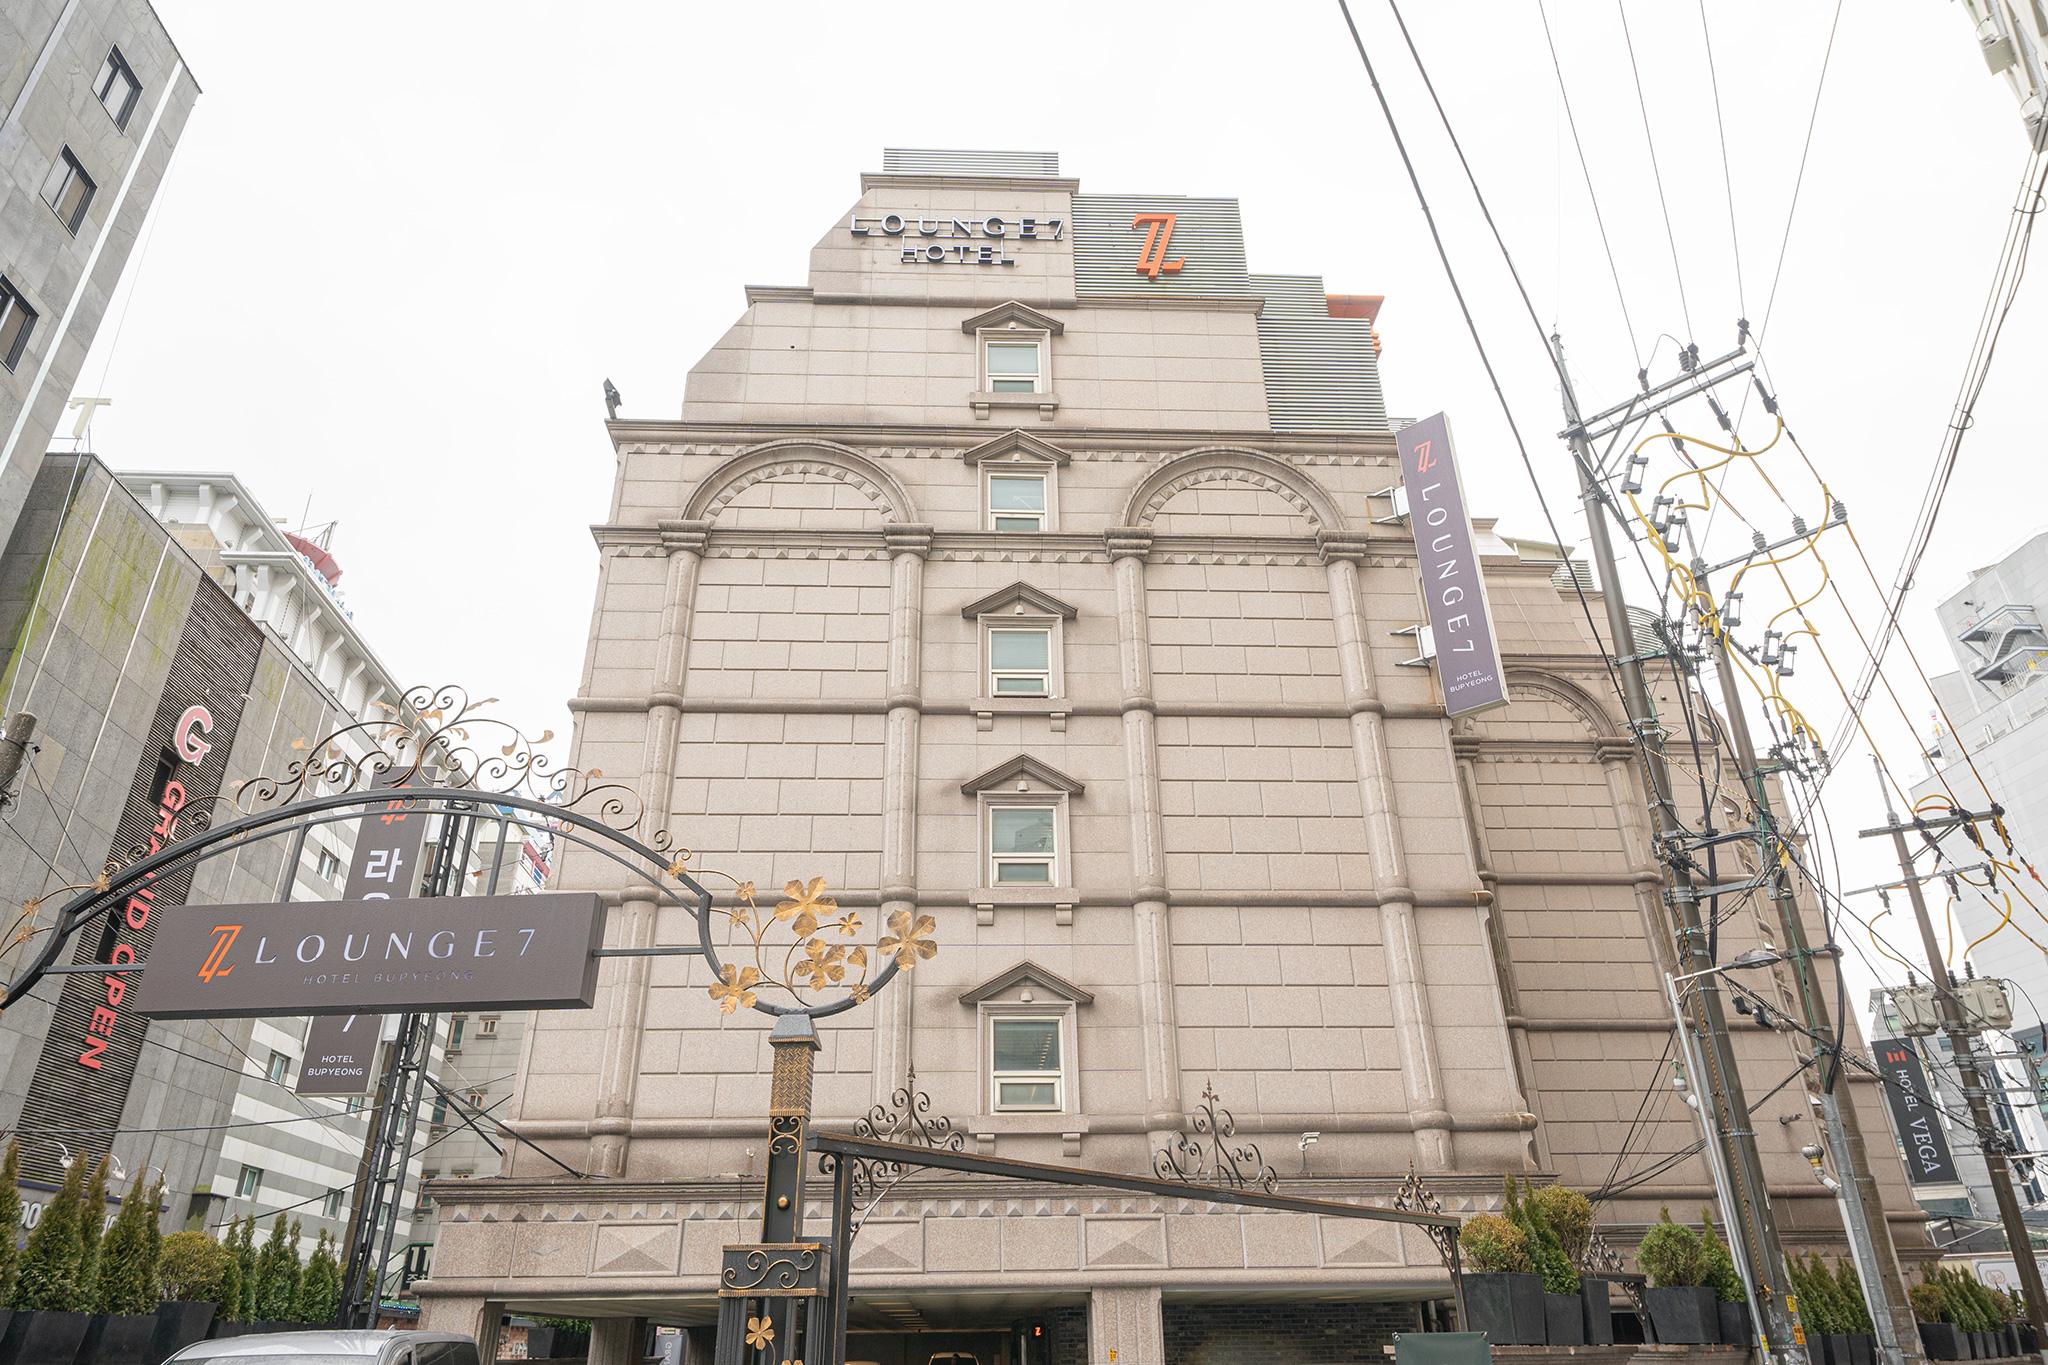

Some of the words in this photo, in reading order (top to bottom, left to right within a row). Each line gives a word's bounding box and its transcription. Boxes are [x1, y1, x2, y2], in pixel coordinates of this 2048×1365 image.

[900, 243, 1015, 265] HOTEL
[1456, 669, 1483, 682] HOTEL
[1449, 675, 1494, 693] BUPYEONG
[303, 973, 361, 985] HOTEL
[373, 969, 475, 983] BUPYEONG
[78, 943, 135, 1070] OPEN
[321, 1055, 355, 1063] HOTEL
[307, 1067, 364, 1076] BUPYEONG
[1909, 1116, 1942, 1175] VEGA
